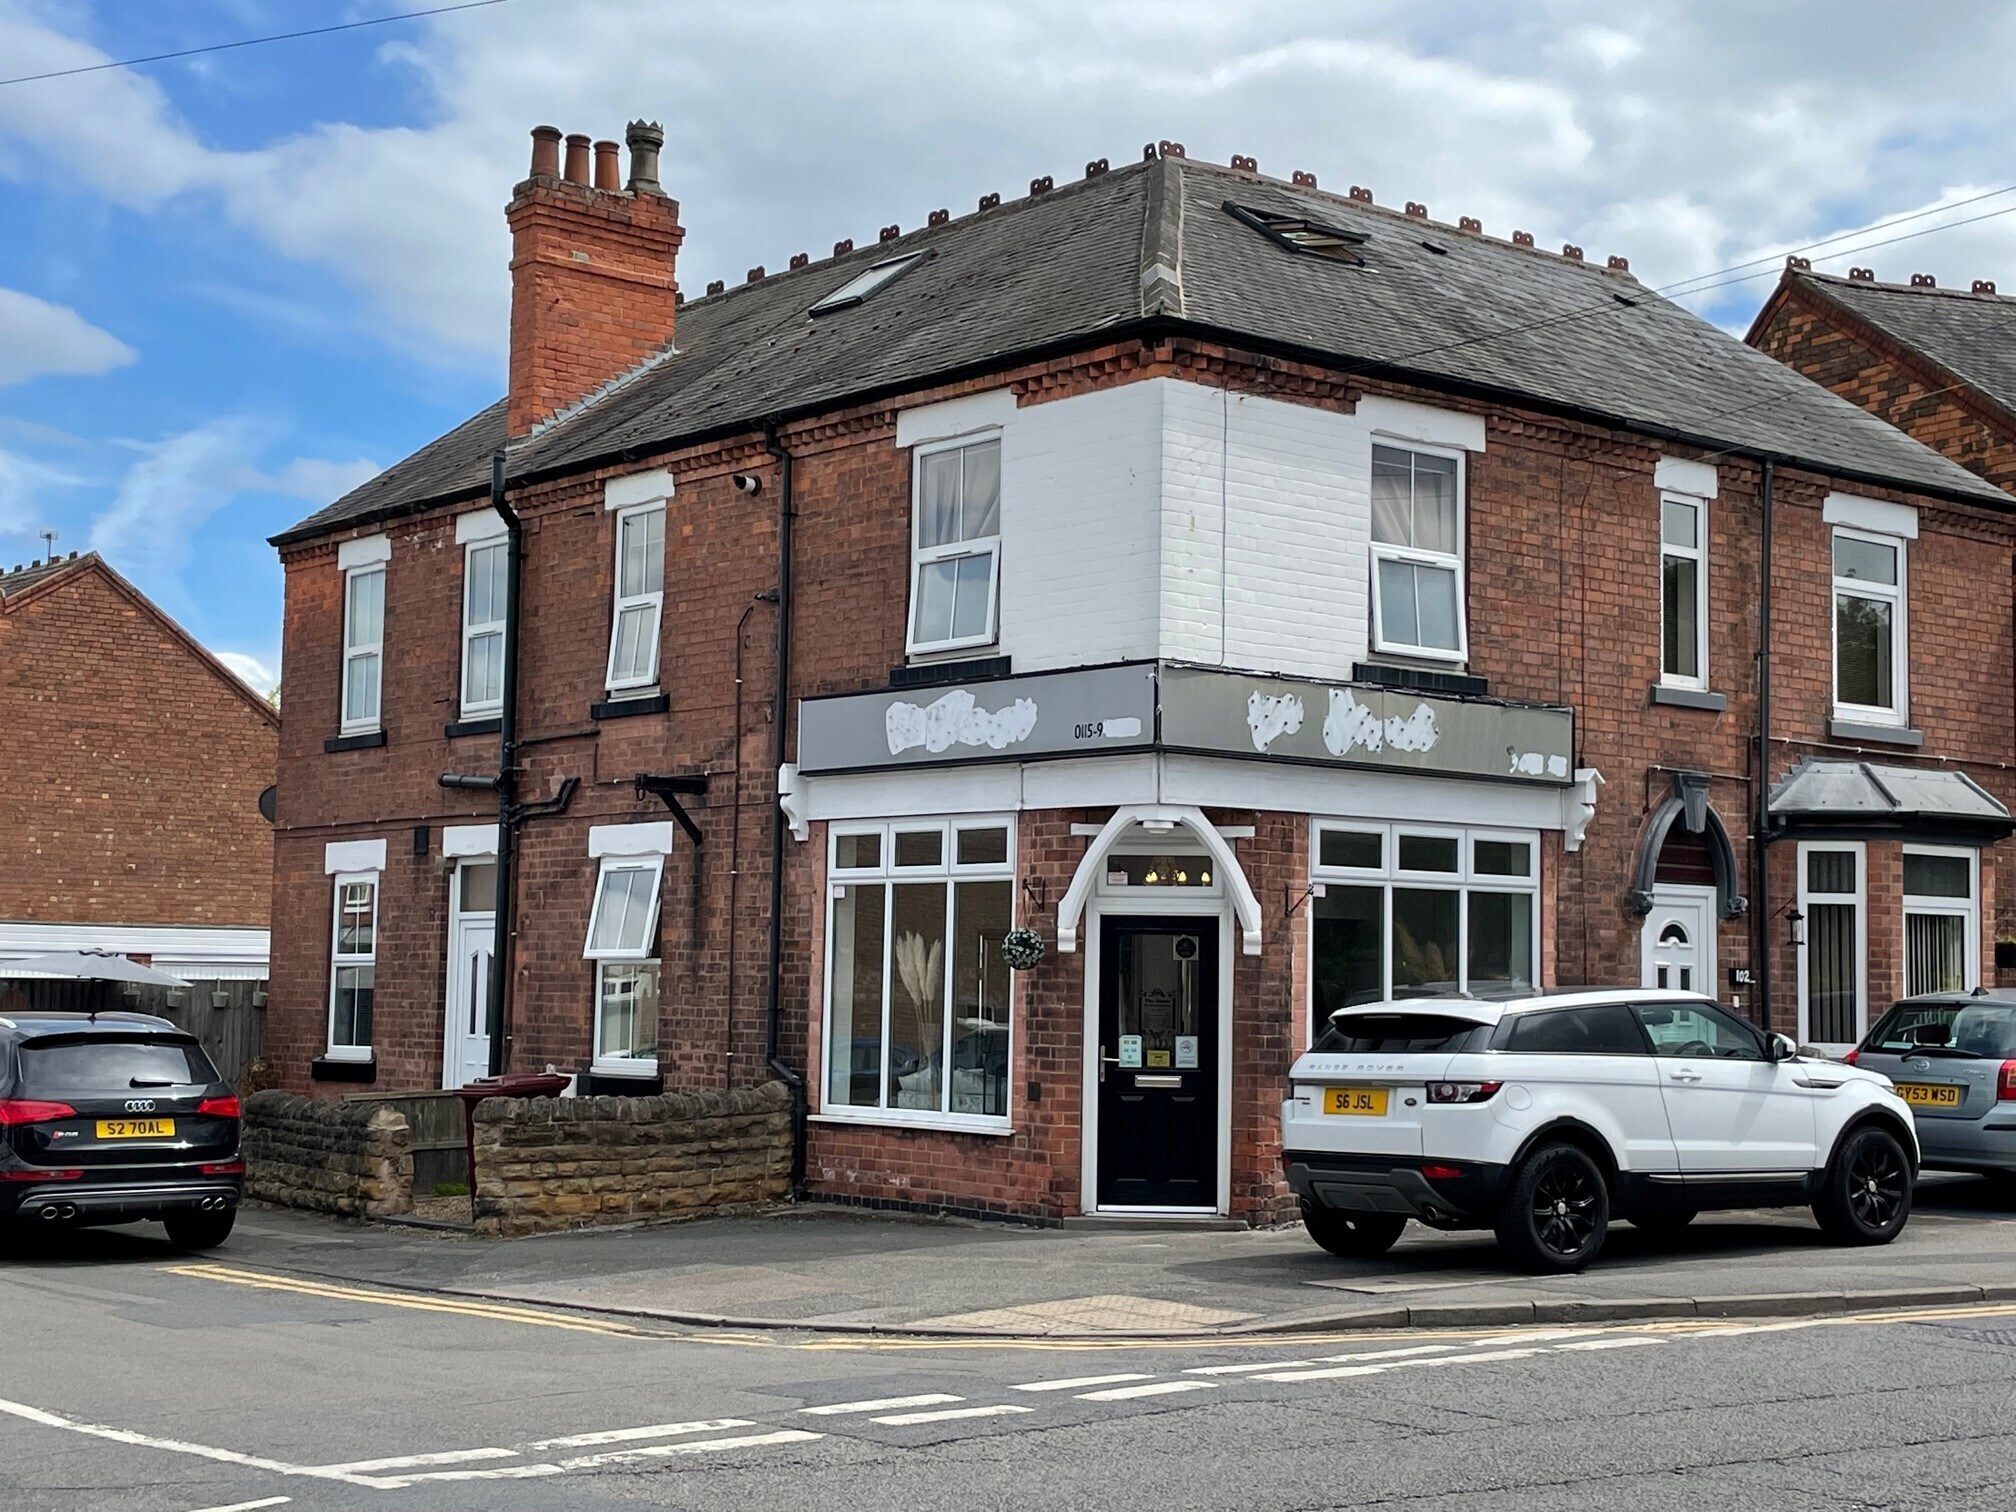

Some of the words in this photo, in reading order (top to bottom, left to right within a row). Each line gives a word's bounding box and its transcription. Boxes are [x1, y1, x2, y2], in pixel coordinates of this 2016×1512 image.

[1356, 1064, 1405, 1072] ROVER
[1336, 1093, 1350, 1109] S6
[1352, 1094, 1374, 1110] JSL
[1931, 1088, 1956, 1102] WSD
[107, 1122, 125, 1135] S2
